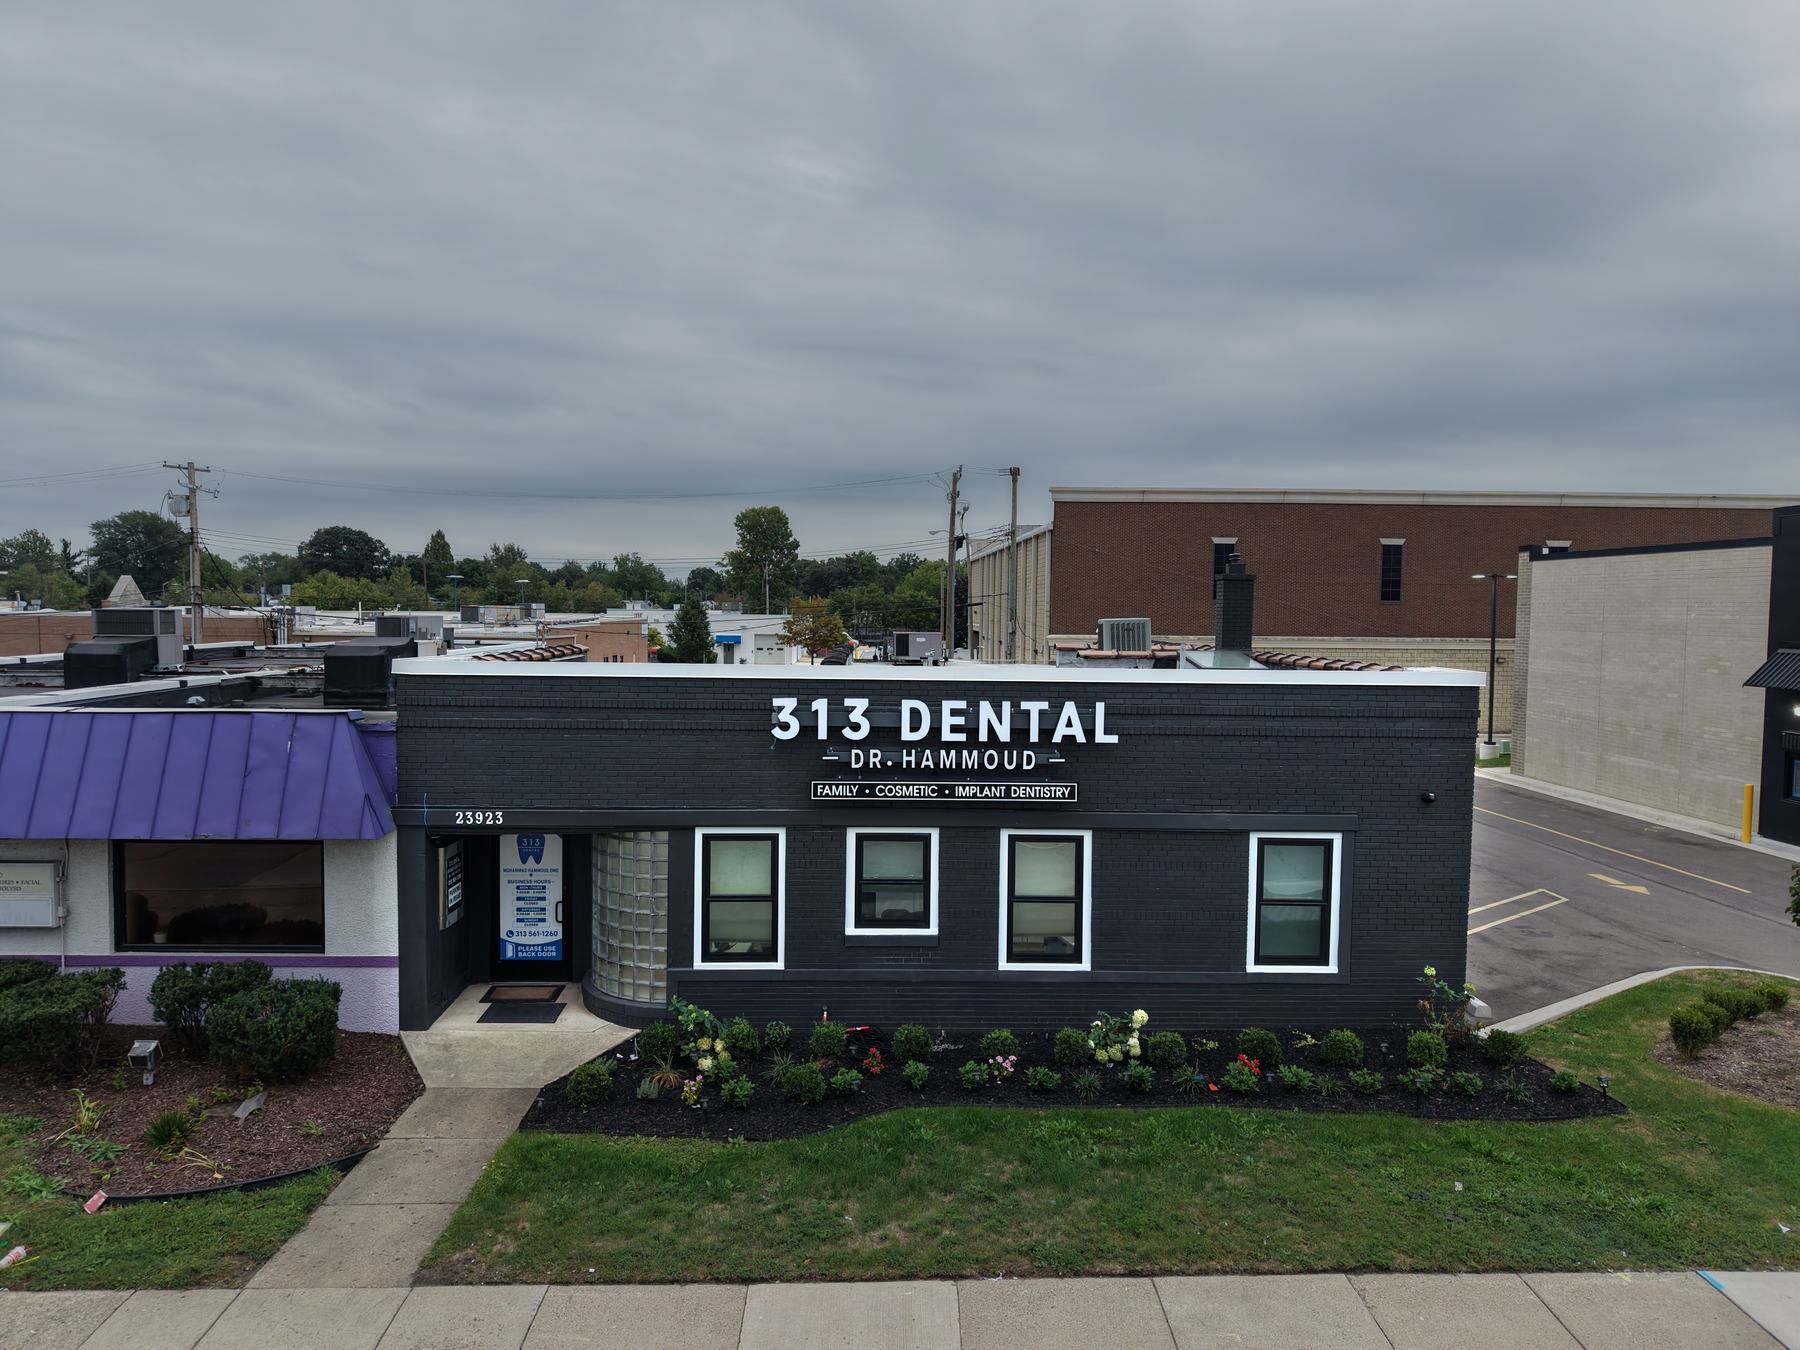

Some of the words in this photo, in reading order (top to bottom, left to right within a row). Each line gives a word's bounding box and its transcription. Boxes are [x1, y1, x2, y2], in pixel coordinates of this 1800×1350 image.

[771, 698, 870, 740] 313
[901, 699, 1119, 743] DENTAL
[851, 749, 893, 769] DR.
[902, 749, 1036, 770] HAMMOUD
[817, 785, 859, 797] FAMILY
[875, 785, 939, 797] COSMETIC
[955, 786, 1006, 798] IMPLANT
[1011, 786, 1071, 798] DENTISTRY
[455, 811, 503, 825] 23923
[522, 838, 540, 846] 313
